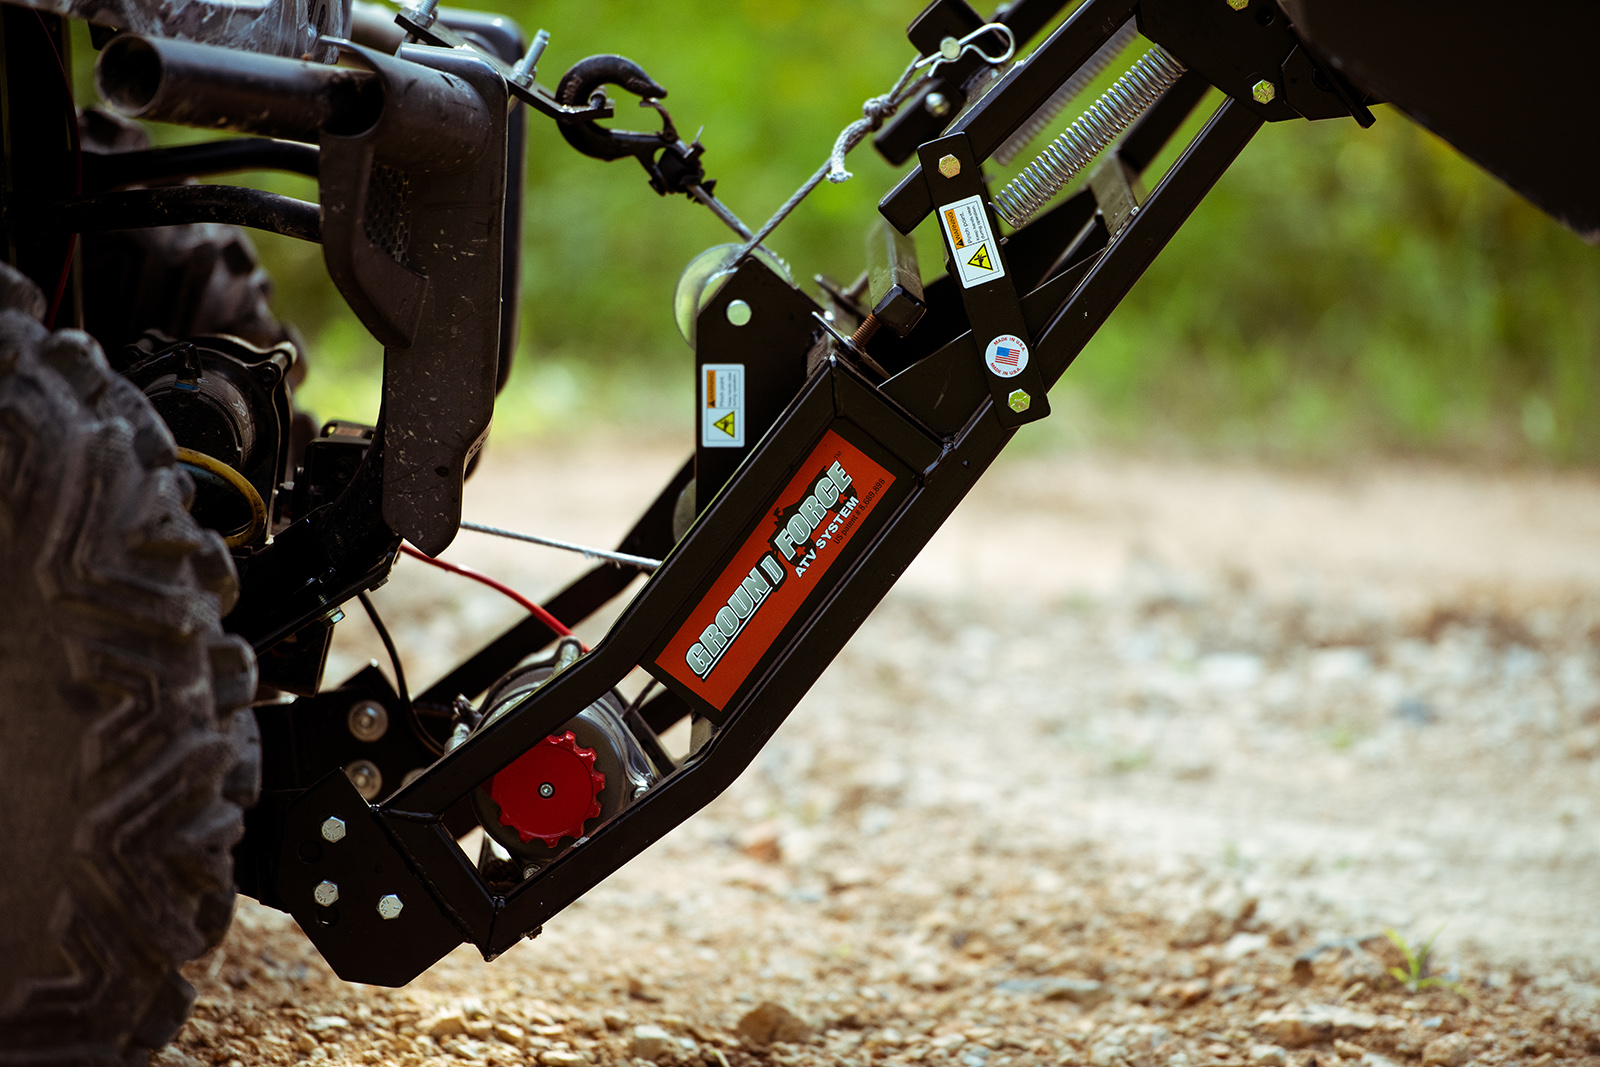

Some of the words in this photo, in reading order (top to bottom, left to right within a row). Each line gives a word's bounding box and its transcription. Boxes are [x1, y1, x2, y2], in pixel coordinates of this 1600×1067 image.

[948, 211, 961, 241] WARNING
[960, 211, 968, 227] point.
[965, 228, 973, 243] Pinch
[994, 337, 1007, 345] MADE
[990, 363, 1001, 374] MADE
[833, 533, 844, 544] US
[841, 514, 859, 536] patent
[858, 477, 886, 511] 8,689,898
[795, 548, 818, 578] ATV
[815, 495, 860, 550] SYSTEM
[685, 555, 784, 676] GROUND
[774, 460, 853, 561] FORCE
